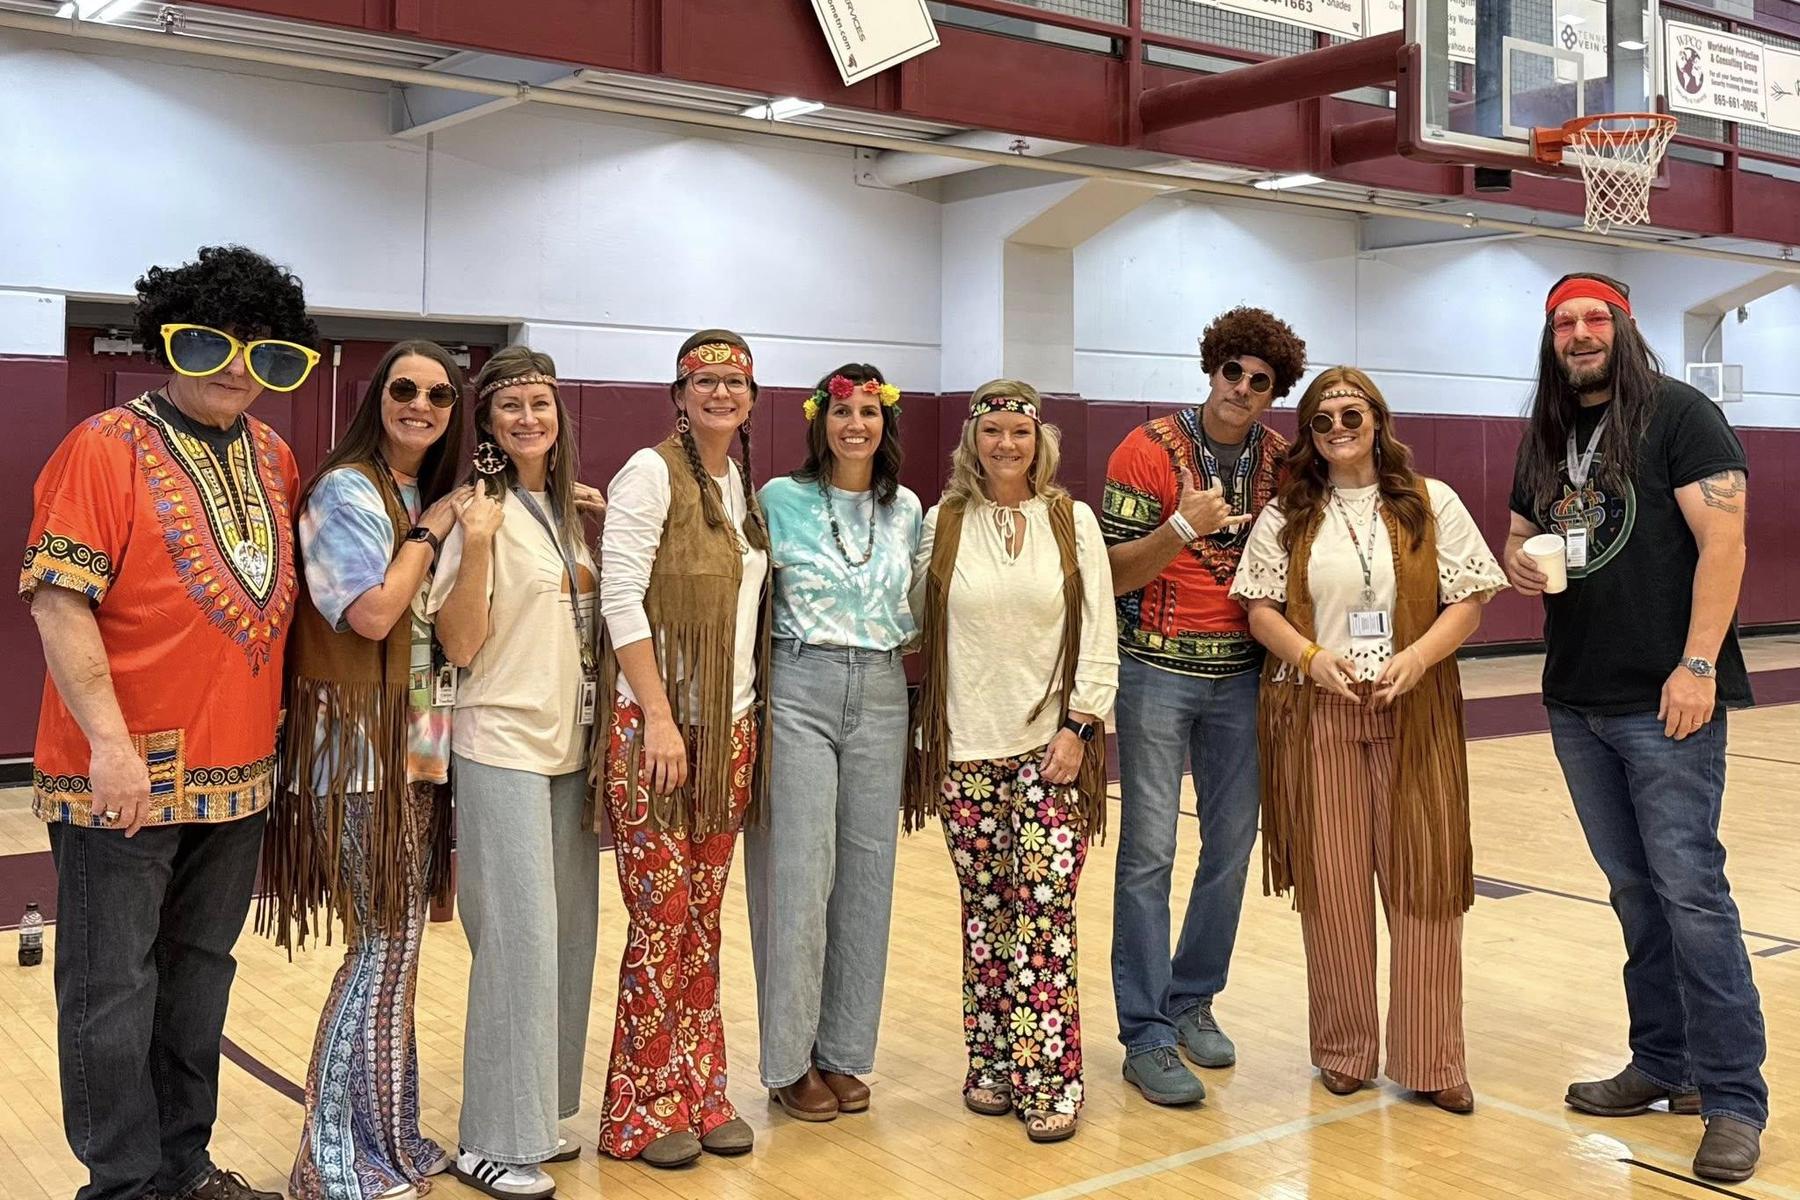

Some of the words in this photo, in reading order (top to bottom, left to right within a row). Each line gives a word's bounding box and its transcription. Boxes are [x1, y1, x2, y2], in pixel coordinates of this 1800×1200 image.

[1579, 39, 1600, 51] VEIN
[1707, 41, 1734, 55] Worldwide
[1736, 47, 1760, 61] Protection
[1716, 54, 1742, 71] Consulting
[1744, 61, 1758, 74] Group
